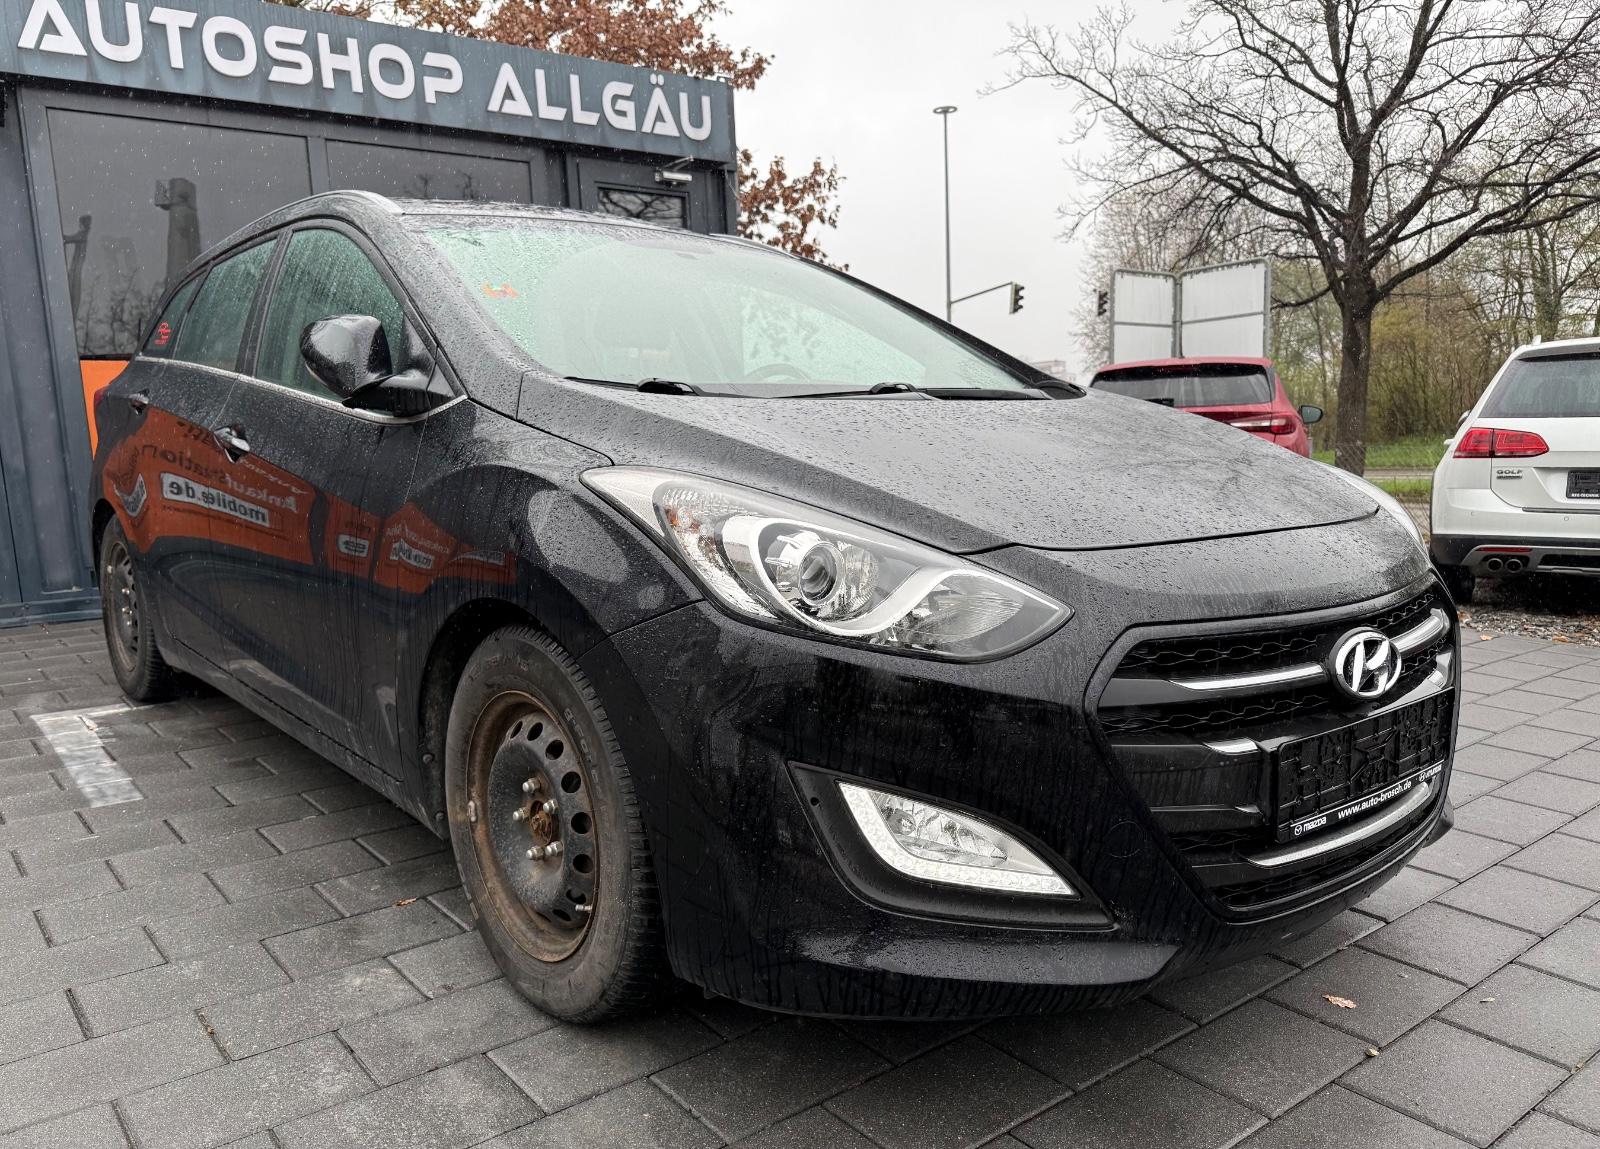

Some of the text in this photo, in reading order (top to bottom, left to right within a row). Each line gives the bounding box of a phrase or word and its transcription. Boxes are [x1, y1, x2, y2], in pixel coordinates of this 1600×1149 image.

[18, 0, 713, 142] AUTOSHOP ALLGÄU
[1303, 816, 1327, 832] mazda
[1338, 781, 1412, 819] www.auto-brosch.de
